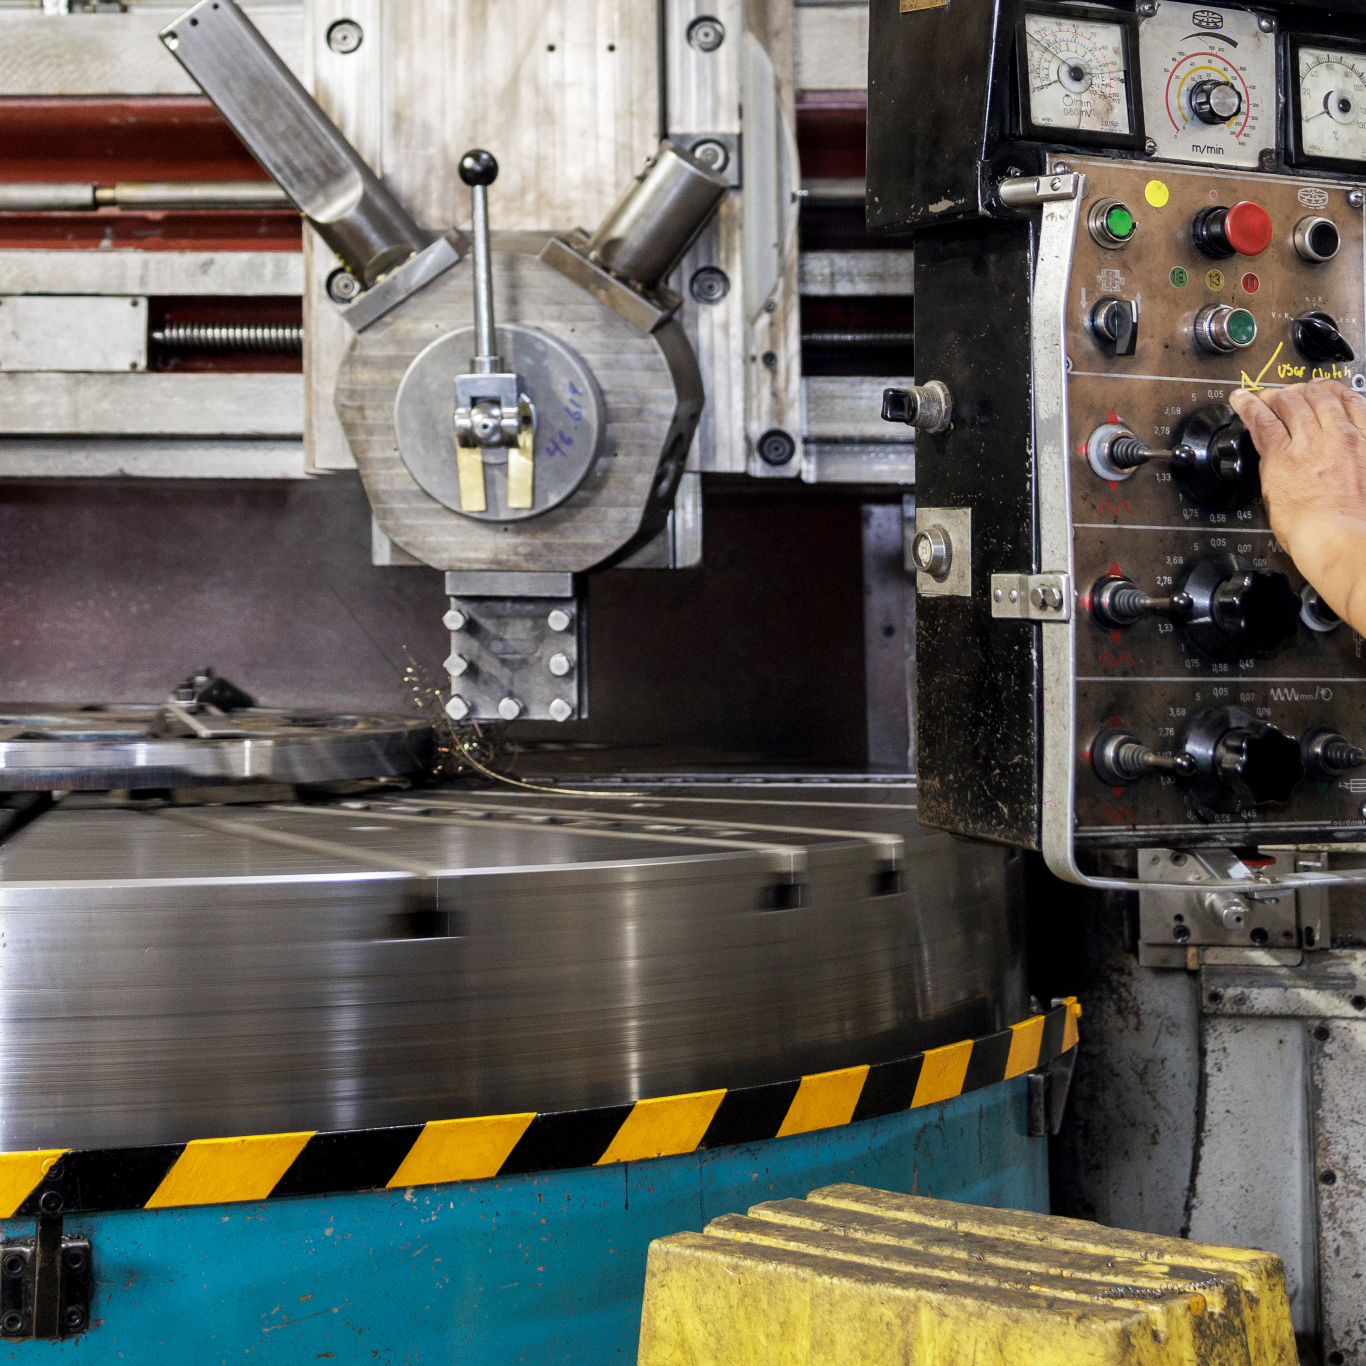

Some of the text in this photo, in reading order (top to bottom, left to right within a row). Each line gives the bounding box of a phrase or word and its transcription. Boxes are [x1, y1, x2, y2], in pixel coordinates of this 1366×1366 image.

[1192, 144, 1224, 154] m/min
[1208, 274, 1220, 286] 1:3
[1192, 393, 1196, 402] 5
[1208, 390, 1224, 399] 0,05
[1164, 406, 1181, 416] 3,68
[1154, 426, 1170, 436] 2,76
[1156, 473, 1172, 482] 1,33
[1183, 508, 1198, 518] 0,75
[1237, 510, 1252, 520] 0,45
[1210, 514, 1226, 523] 0,56
[1210, 538, 1226, 548] 0,05
[1238, 544, 1252, 554] 0,07
[1166, 556, 1184, 566] 3,68
[1253, 558, 1267, 567] 0,09
[1156, 576, 1172, 586] 2,76
[1158, 624, 1173, 634] 1,33
[1185, 659, 1200, 668] 0,75
[1212, 664, 1228, 672] 0,56
[1240, 660, 1254, 670] 0,45
[1196, 693, 1200, 701] 5
[1212, 688, 1228, 698] 0,05
[1240, 693, 1255, 702] 0,07
[1169, 708, 1186, 718] 3,68
[1256, 708, 1271, 717] 0,09
[1158, 728, 1174, 736] 2,76
[1242, 810, 1256, 820] 0,45
